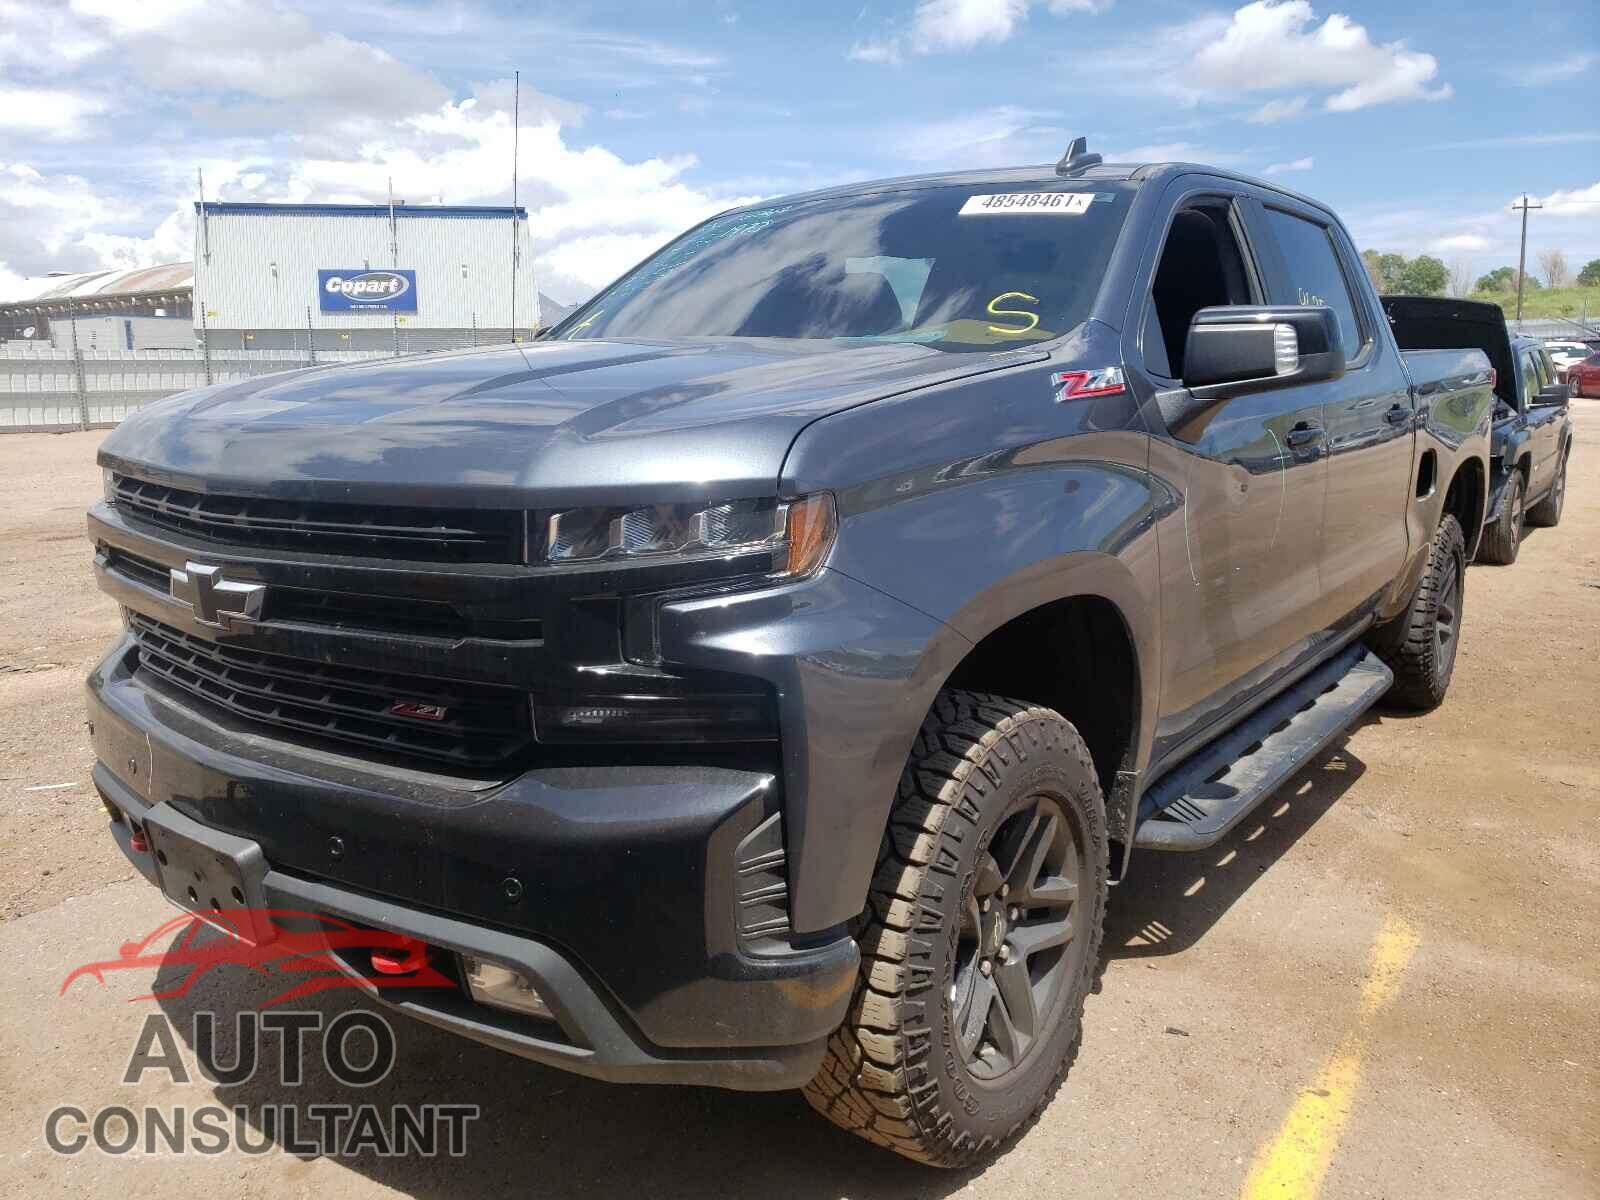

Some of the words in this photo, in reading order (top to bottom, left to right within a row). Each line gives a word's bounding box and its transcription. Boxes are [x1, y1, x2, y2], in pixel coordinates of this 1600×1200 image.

[982, 193, 1075, 208] 48548461
[326, 276, 400, 295] Copart
[987, 291, 1041, 335] S
